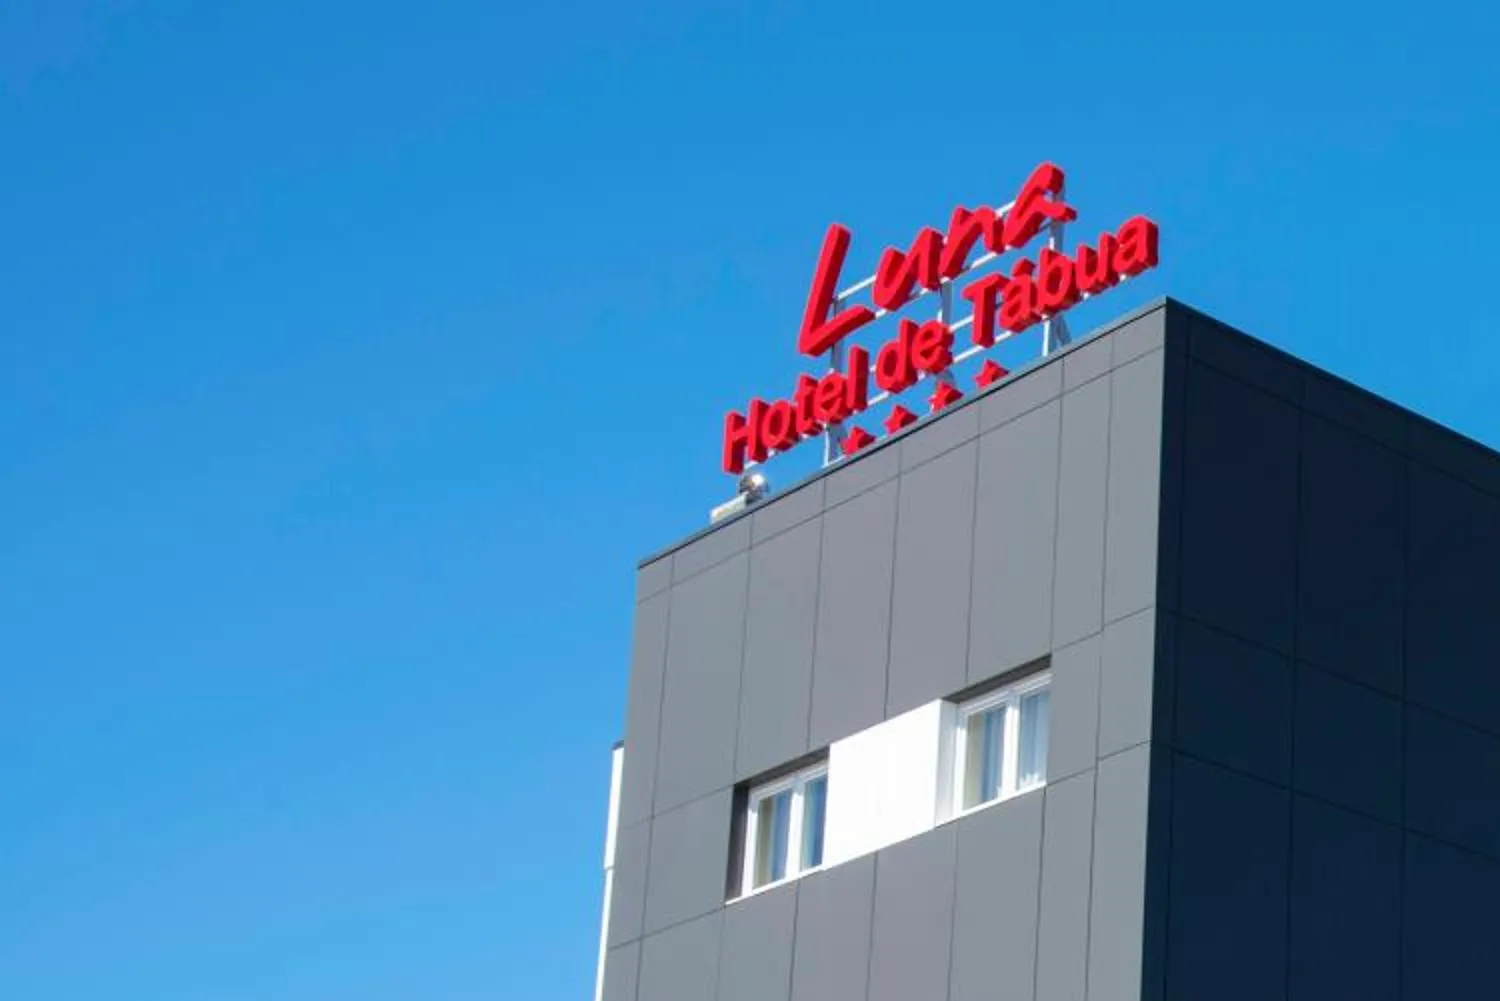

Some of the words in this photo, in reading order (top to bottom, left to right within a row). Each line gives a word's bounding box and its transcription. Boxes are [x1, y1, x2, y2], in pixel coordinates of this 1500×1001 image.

[722, 345, 868, 475] Hotel
[875, 319, 954, 393] de
[961, 216, 1159, 347] Tábua
[798, 161, 1077, 357] Luna
